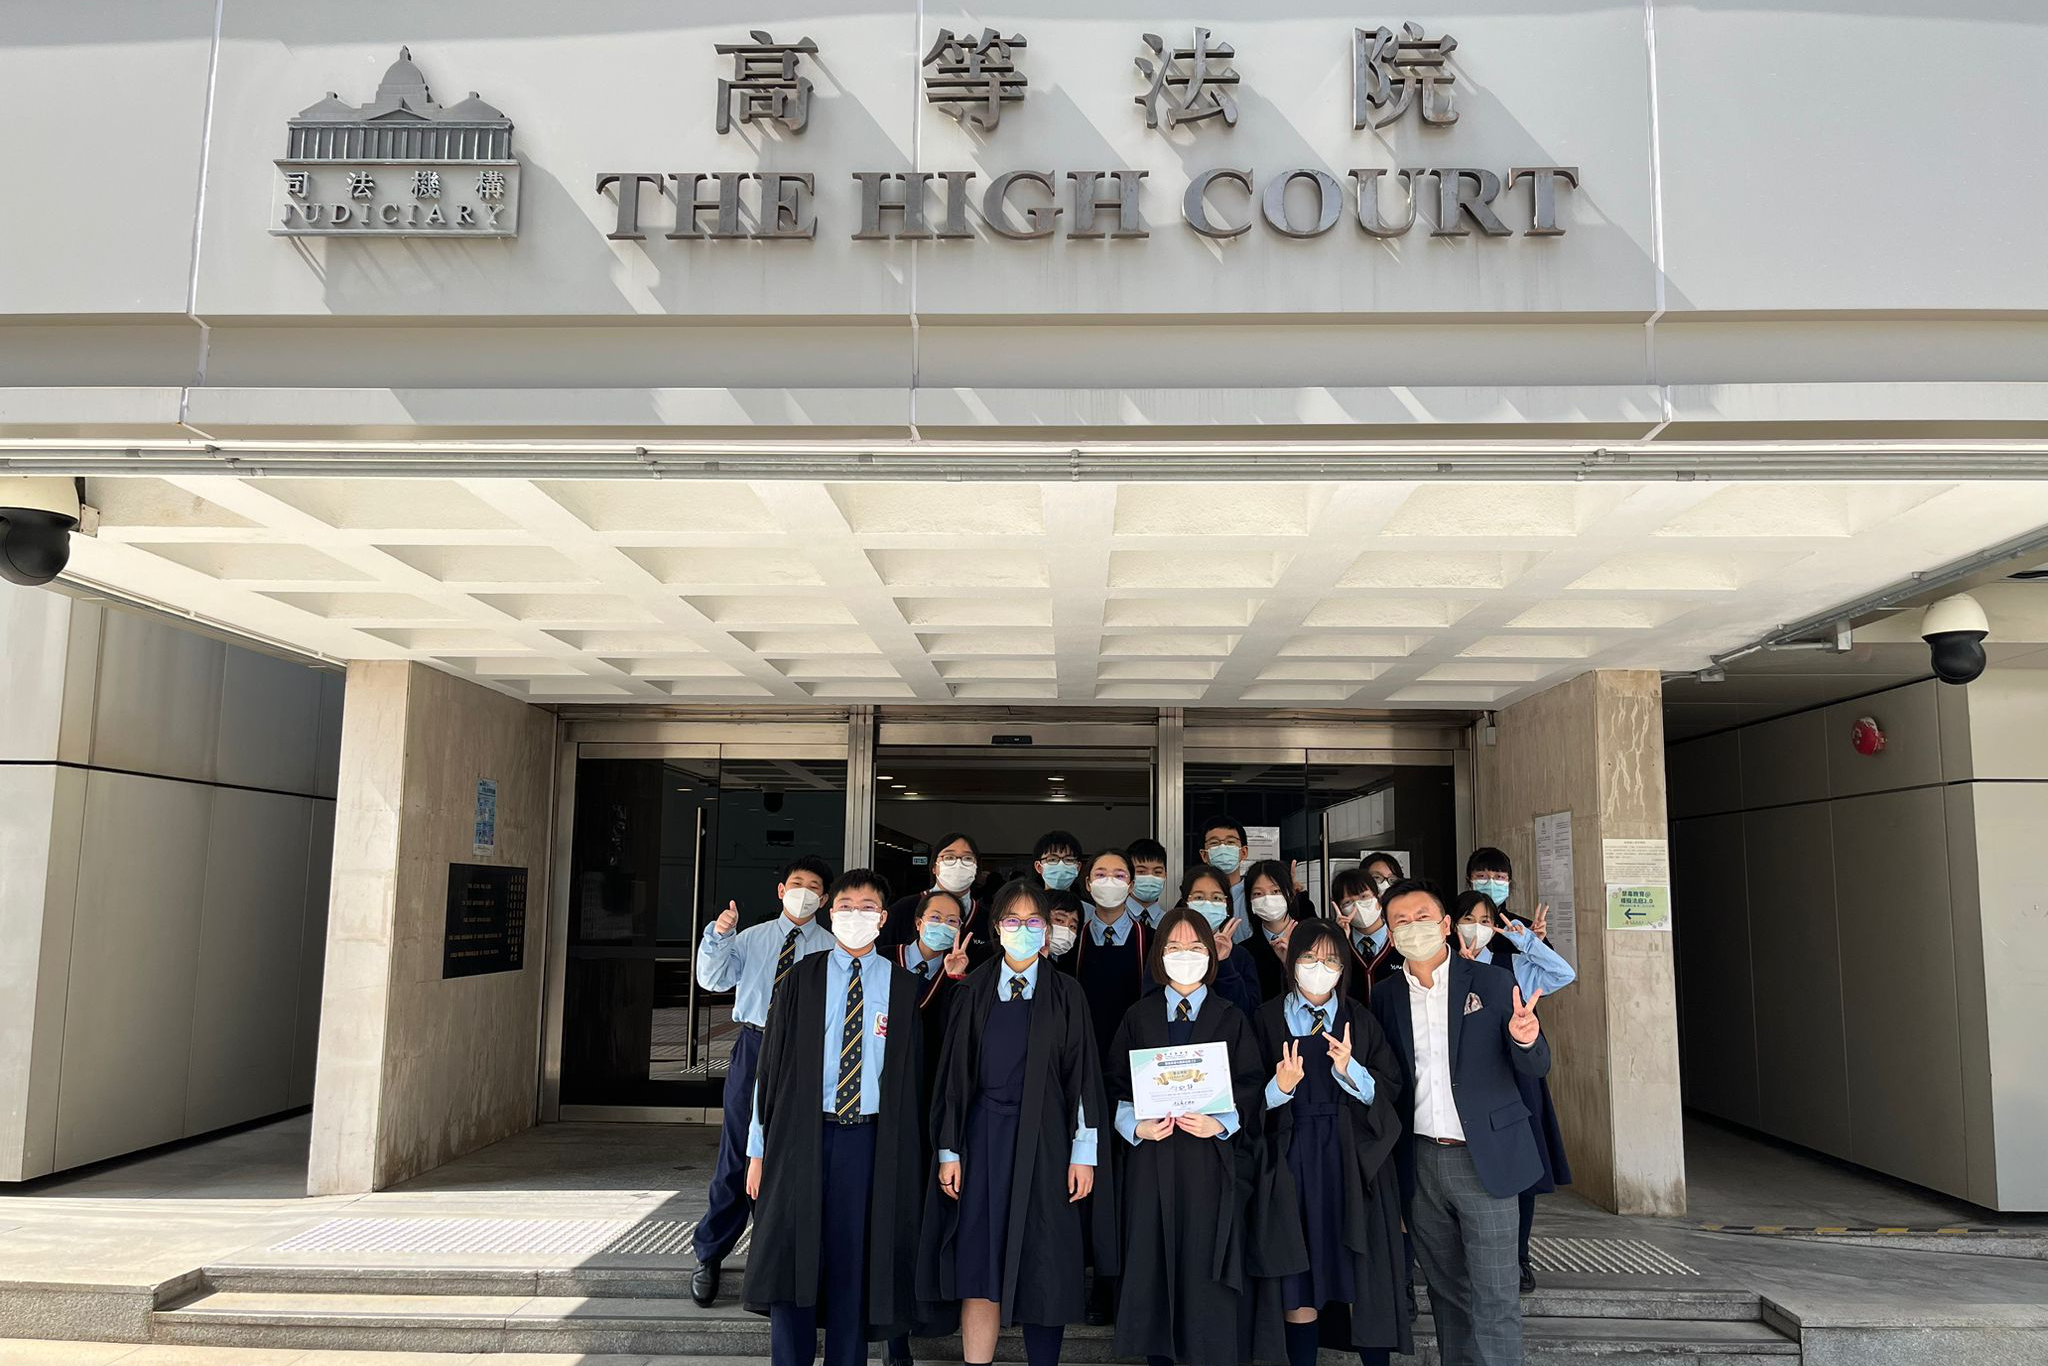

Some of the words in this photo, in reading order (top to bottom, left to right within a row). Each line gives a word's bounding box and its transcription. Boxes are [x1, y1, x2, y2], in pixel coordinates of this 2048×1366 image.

[715, 21, 1458, 134] 高等法院
[285, 170, 505, 200] 司法機構
[596, 172, 817, 241] THE
[851, 170, 1150, 241] HIGH
[1182, 167, 1579, 239] COURT
[281, 203, 505, 226] JUDICIARY
